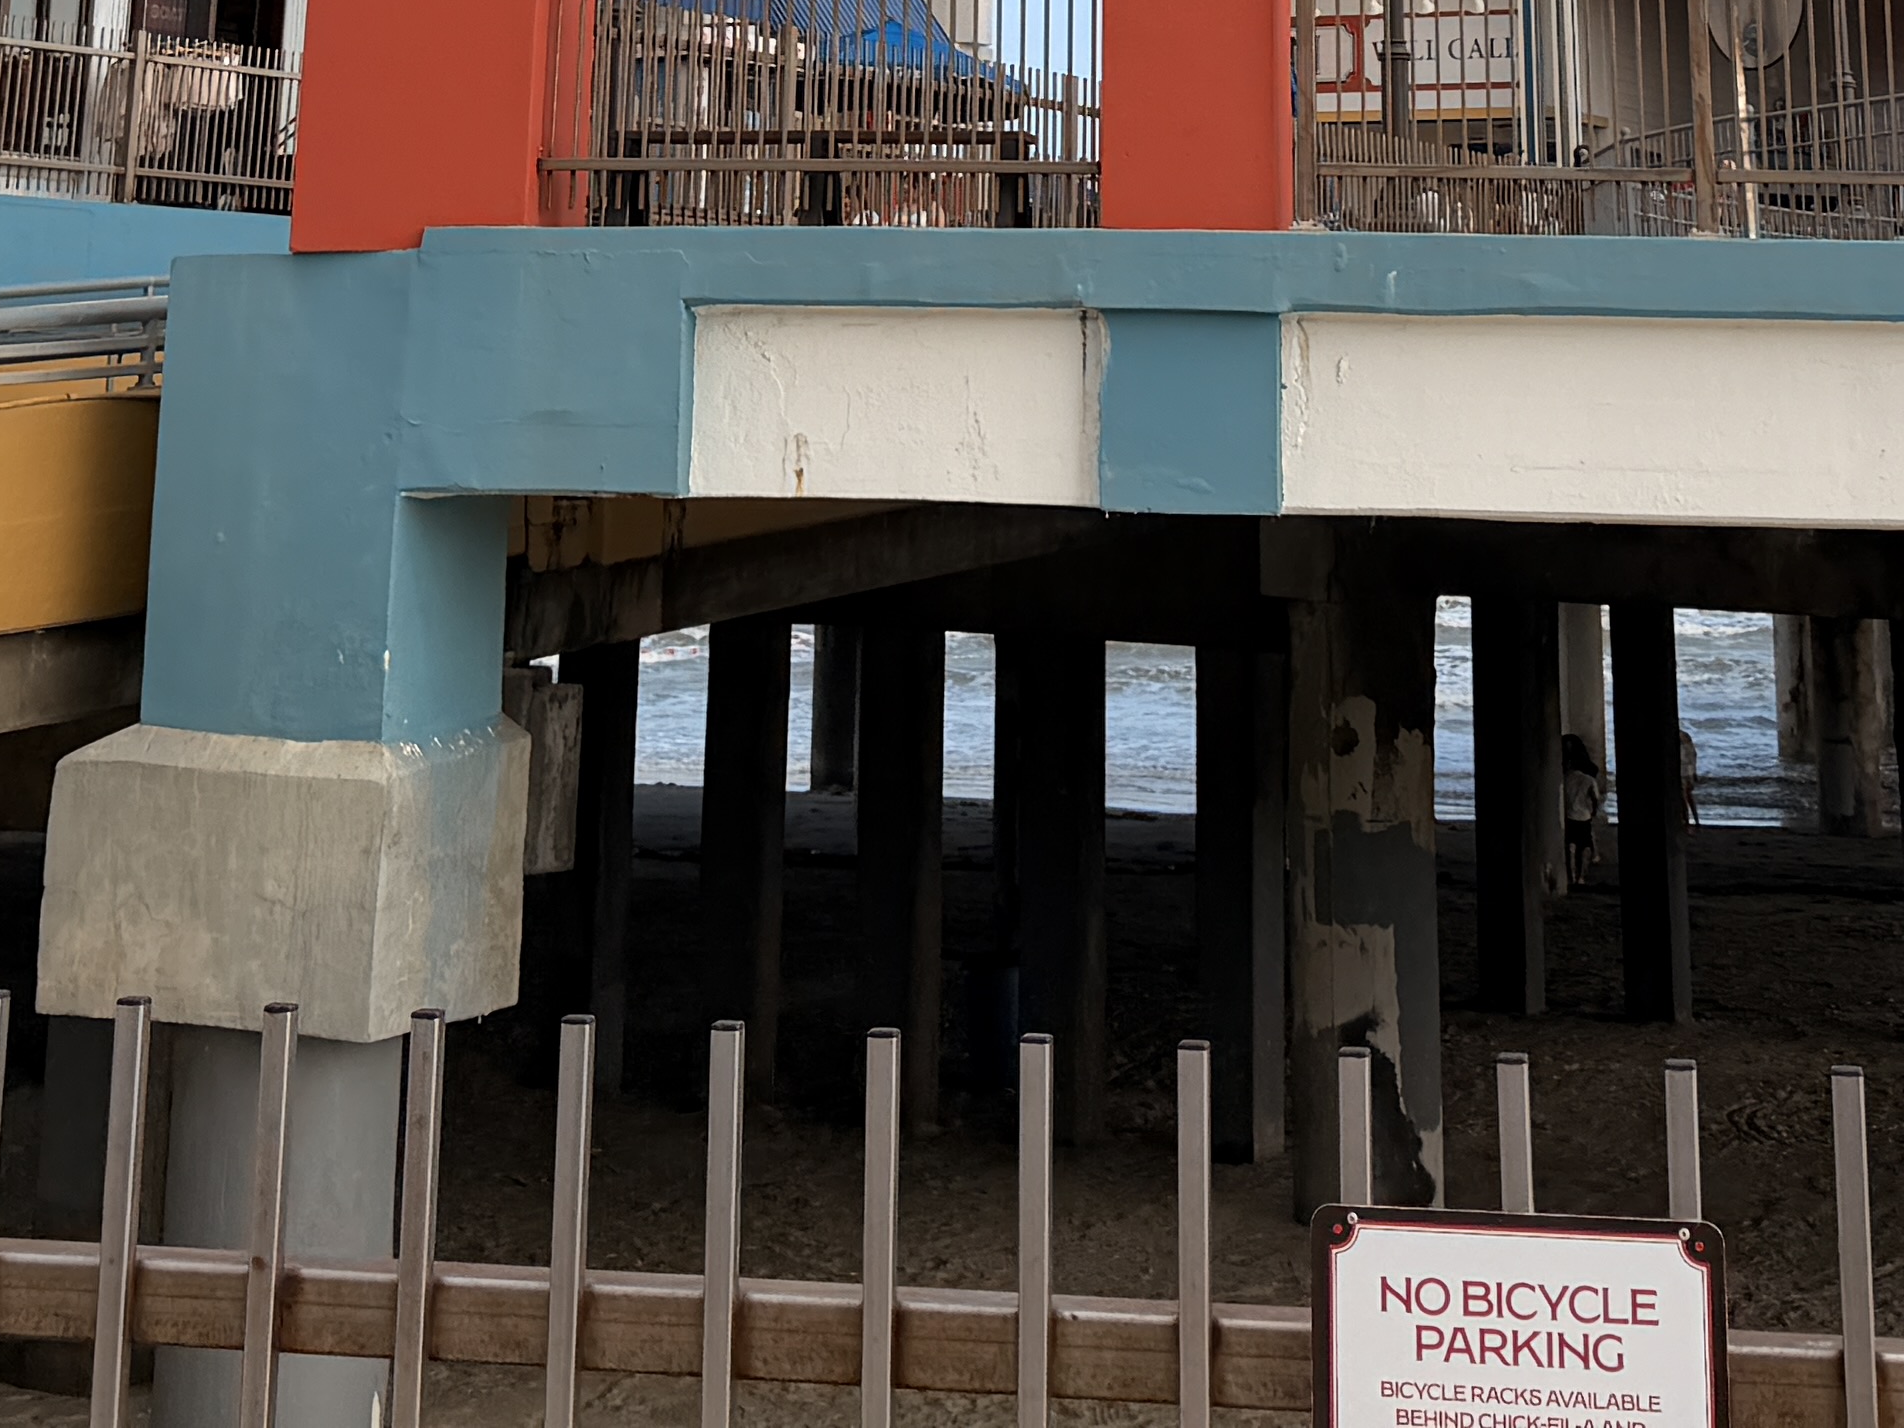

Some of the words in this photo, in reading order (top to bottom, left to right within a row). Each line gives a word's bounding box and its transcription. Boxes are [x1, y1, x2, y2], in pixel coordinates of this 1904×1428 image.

[1380, 1276, 1451, 1316] NO
[1462, 1280, 1660, 1326] BICYCLE
[1415, 1325, 1625, 1373] PARKING
[1380, 1380, 1467, 1403] BICYCLE
[1471, 1385, 1542, 1407] RACKS
[1546, 1390, 1663, 1413] AVAILABLE
[1396, 1408, 1474, 1428] BEHIND
